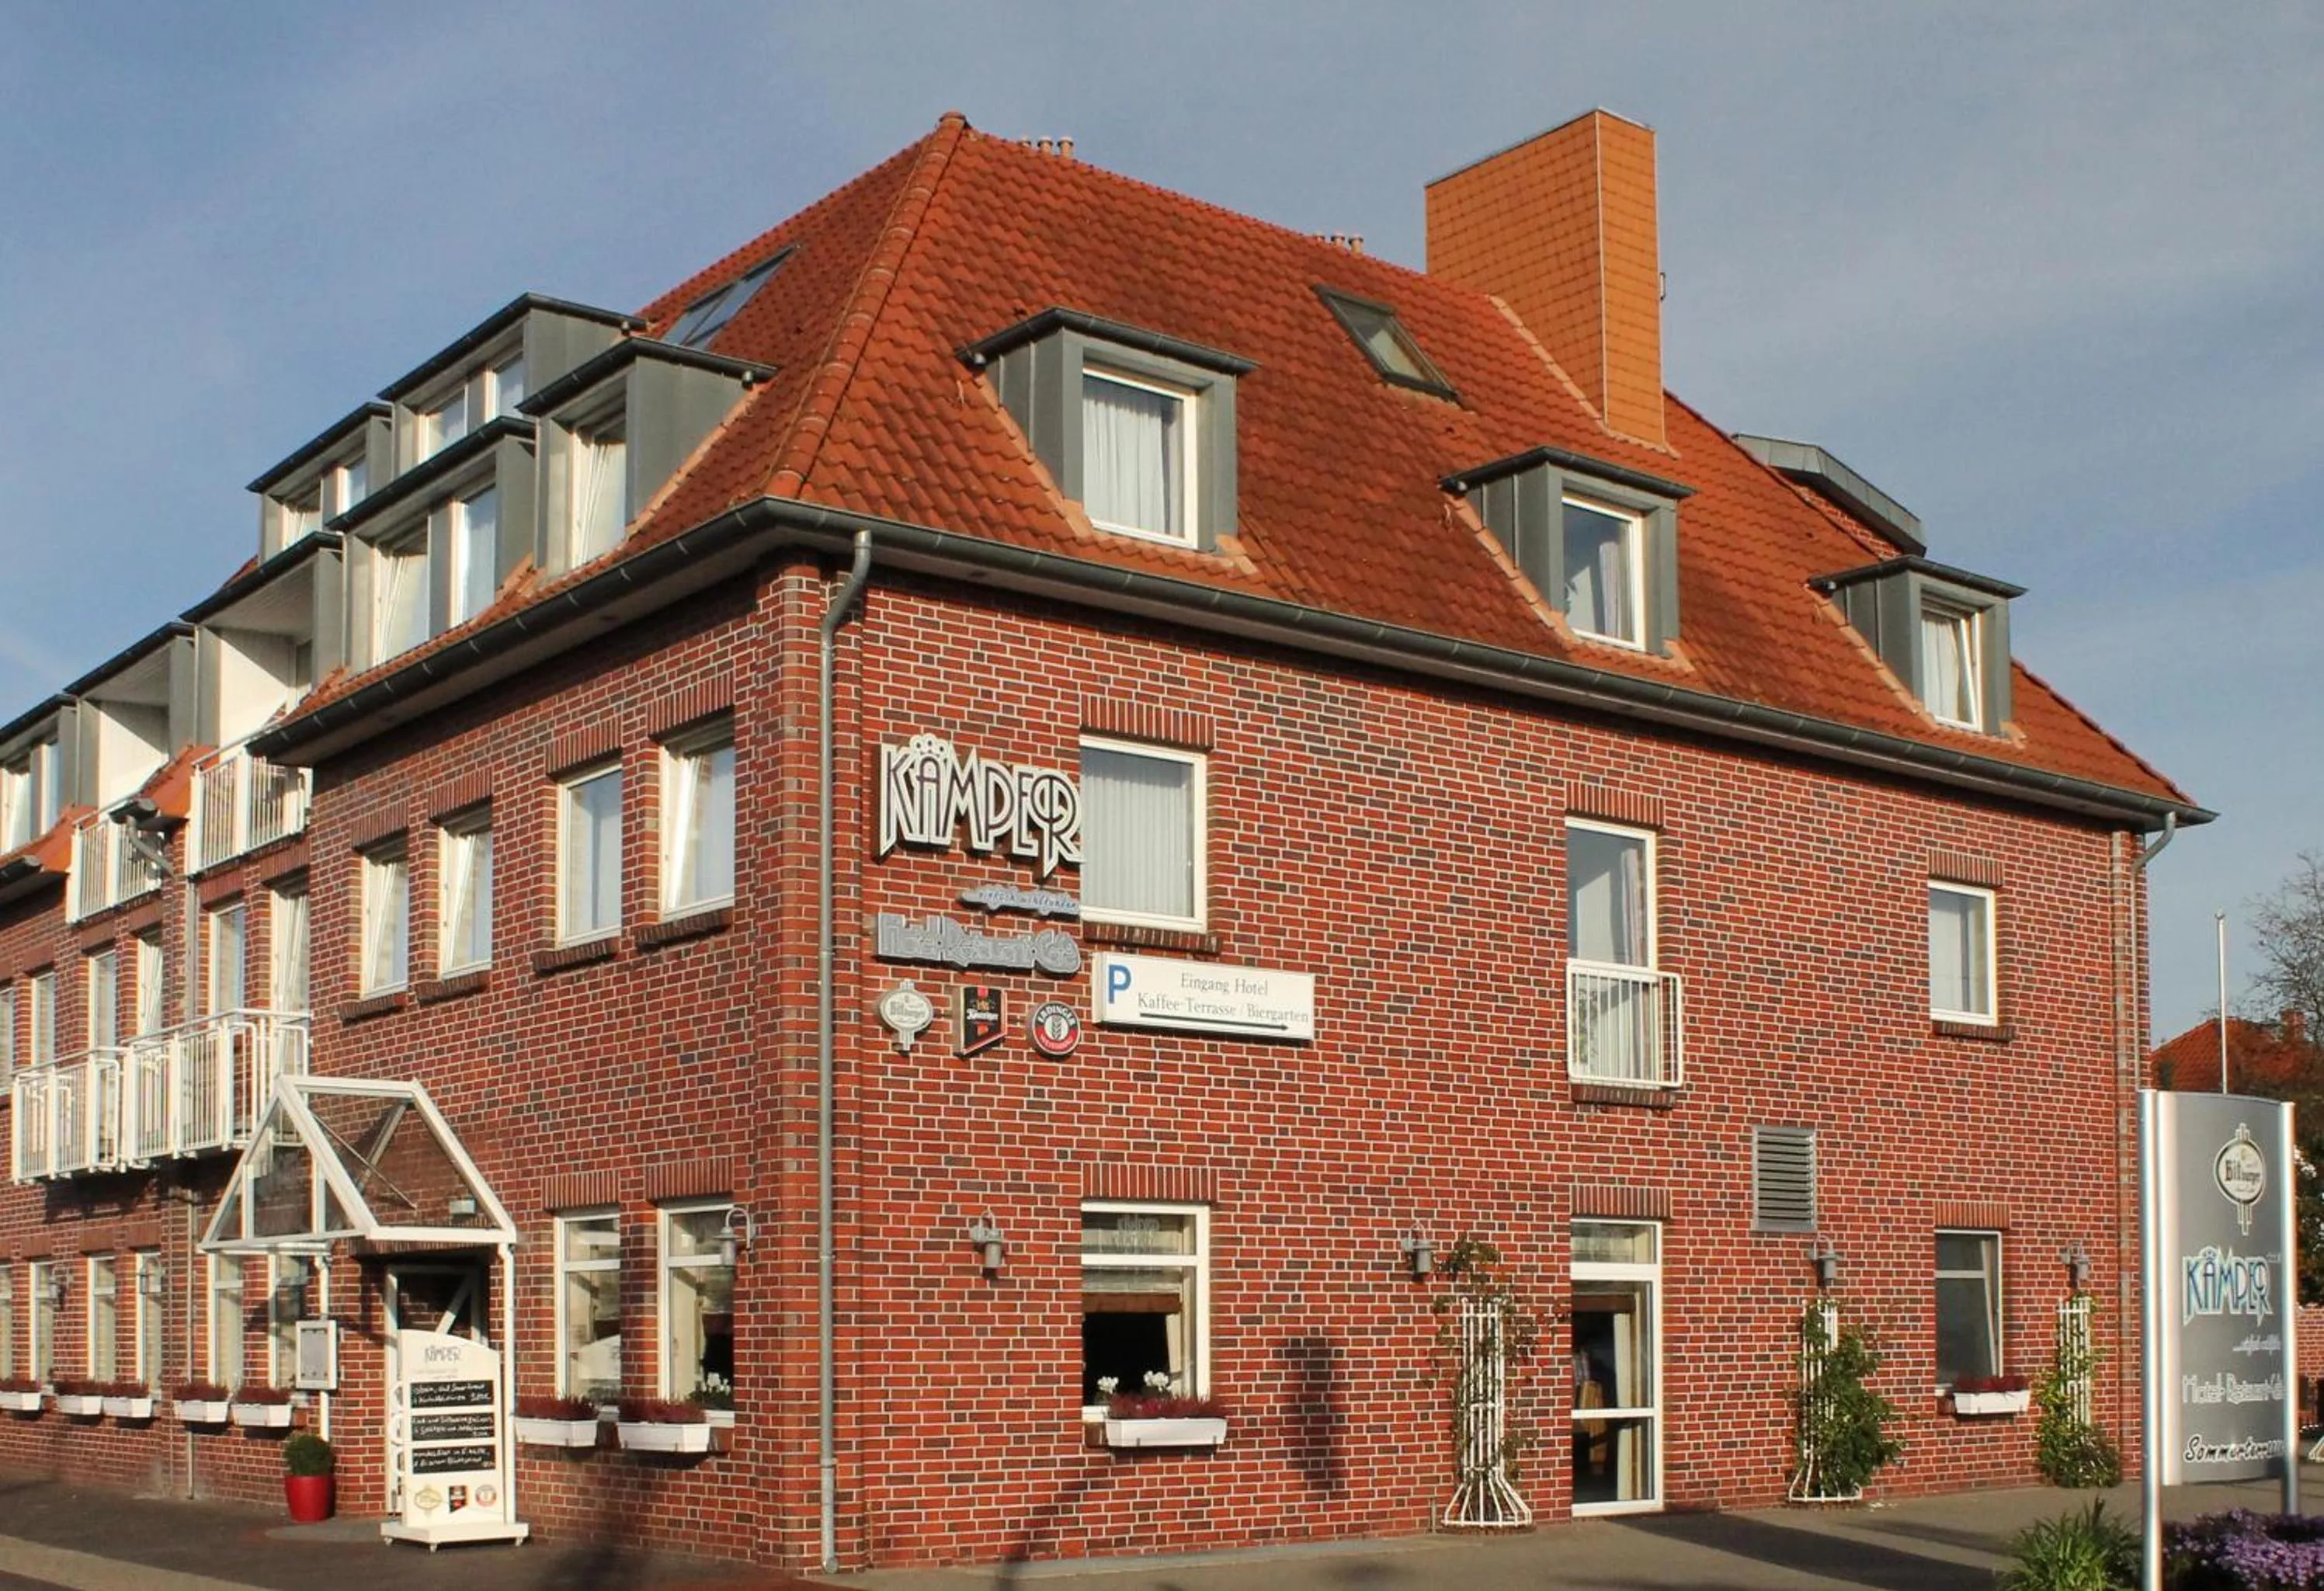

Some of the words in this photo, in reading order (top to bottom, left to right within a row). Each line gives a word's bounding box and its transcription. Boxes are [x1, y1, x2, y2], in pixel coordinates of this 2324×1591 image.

[880, 733, 1082, 877] KÄMPER
[1108, 964, 1131, 1004] P
[1181, 972, 1229, 992] Eingang
[1235, 978, 1269, 995] Hotel
[1247, 1003, 1309, 1023] Biergarten
[2183, 1245, 2274, 1327] KÄMPER
